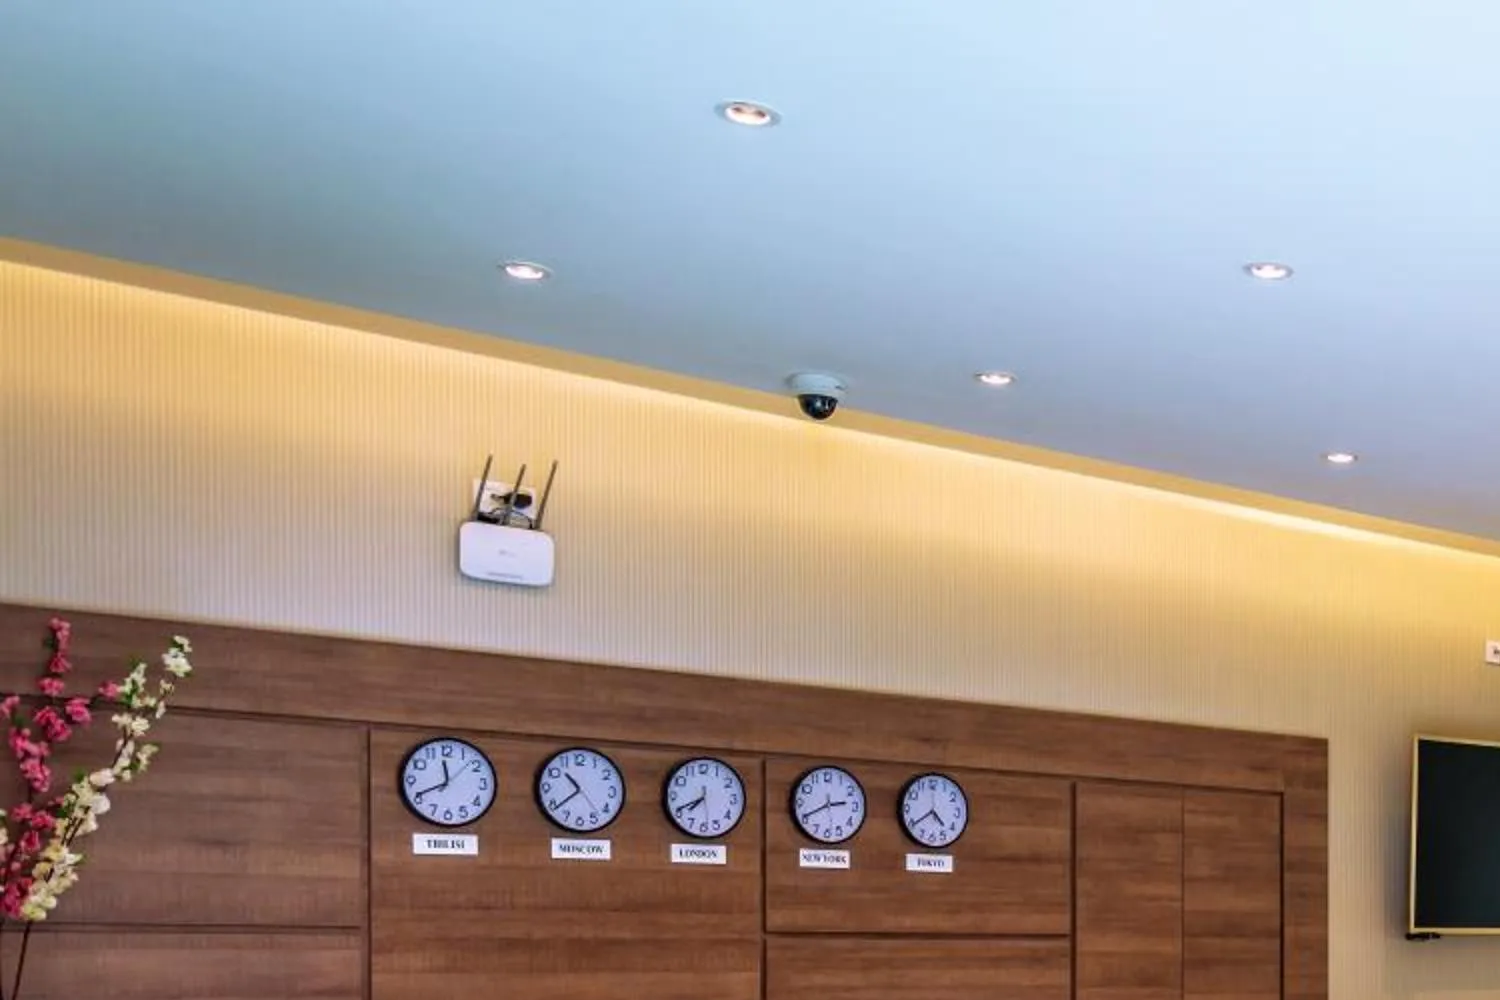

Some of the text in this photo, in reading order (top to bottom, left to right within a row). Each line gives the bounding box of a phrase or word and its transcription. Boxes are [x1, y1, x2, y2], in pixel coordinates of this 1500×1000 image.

[680, 848, 717, 857] LONDON
[802, 854, 846, 863] NEW YORK
